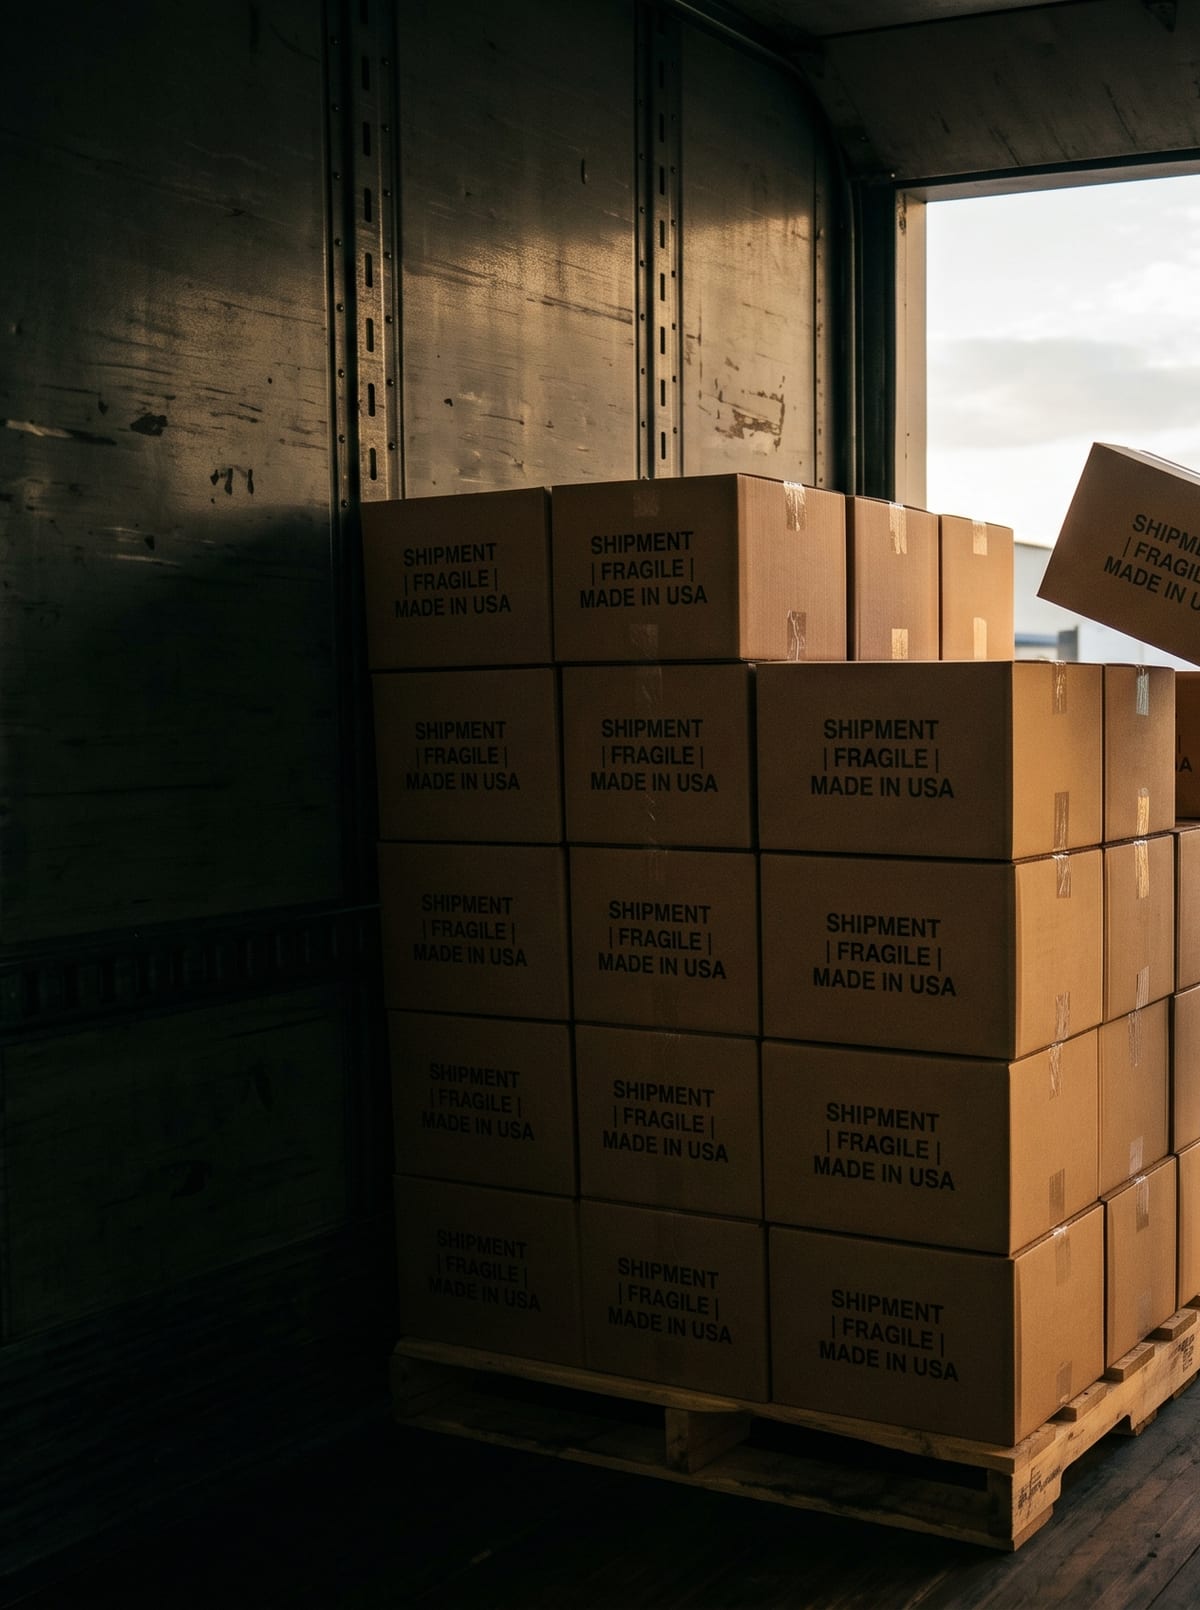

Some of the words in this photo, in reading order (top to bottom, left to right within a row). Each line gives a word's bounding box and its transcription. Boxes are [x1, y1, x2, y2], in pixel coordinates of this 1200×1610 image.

[403, 542, 497, 567] SHIPMENT
[590, 530, 694, 555] SHIPMENT
[413, 569, 489, 592] FRAGILE
[601, 558, 684, 581] FRAGILE
[1103, 555, 1162, 594] MADE
[1164, 581, 1187, 604] IN
[394, 597, 446, 618] MADE
[450, 596, 467, 616] IN
[473, 594, 512, 615] USA
[579, 587, 636, 609] MADE
[641, 586, 660, 607] IN
[667, 584, 708, 606] USA
[415, 720, 507, 740] SHIPMENT
[601, 718, 704, 738] SHIPMENT
[823, 718, 939, 740] SHIPMENT
[424, 746, 499, 765] FRAGILE
[611, 745, 695, 765] FRAGILE
[834, 747, 928, 769] FRAGILE
[406, 772, 457, 791] MADE
[461, 772, 478, 790] IN
[483, 772, 521, 791] USA
[590, 771, 647, 791] MADE
[652, 773, 671, 792] IN
[677, 773, 719, 793] USA
[811, 775, 874, 796] MADE
[880, 776, 901, 797] IN
[908, 777, 955, 799] USA
[421, 893, 514, 915] SHIPMENT
[608, 900, 711, 925] SHIPMENT
[431, 919, 507, 941] FRAGILE
[826, 912, 941, 939] SHIPMENT
[618, 927, 702, 951] FRAGILE
[413, 943, 464, 963] MADE
[467, 946, 485, 965] IN
[489, 946, 528, 967] USA
[598, 951, 654, 974] MADE
[659, 956, 678, 976] IN
[684, 958, 727, 980] USA
[837, 941, 931, 967] FRAGILE
[813, 967, 876, 991] MADE
[882, 972, 903, 993] IN
[910, 973, 957, 997] USA
[429, 1061, 521, 1089] SHIPMENT
[438, 1088, 513, 1114] FRAGILE
[613, 1079, 715, 1108] SHIPMENT
[421, 1110, 471, 1134] MADE
[475, 1117, 492, 1137] IN
[497, 1119, 535, 1141] USA
[623, 1106, 705, 1134] FRAGILE
[826, 1102, 940, 1133] SHIPMENT
[602, 1129, 658, 1155] MADE
[663, 1137, 682, 1157] IN
[687, 1140, 729, 1164] USA
[837, 1130, 929, 1160] FRAGILE
[813, 1155, 876, 1181] MADE
[882, 1163, 902, 1185] IN
[909, 1166, 956, 1191] USA
[437, 1228, 528, 1260] SHIPMENT
[617, 1257, 719, 1290] SHIPMENT
[427, 1275, 478, 1301] MADE
[482, 1285, 499, 1305] IN
[504, 1287, 542, 1313] USA
[628, 1284, 709, 1316] FRAGILE
[831, 1289, 945, 1325] SHIPMENT
[608, 1306, 663, 1333] MADE
[667, 1316, 686, 1337] IN
[691, 1320, 733, 1345] USA
[842, 1317, 934, 1351] FRAGILE
[819, 1340, 880, 1369] MADE
[886, 1351, 907, 1374] IN
[913, 1356, 959, 1383] USA
